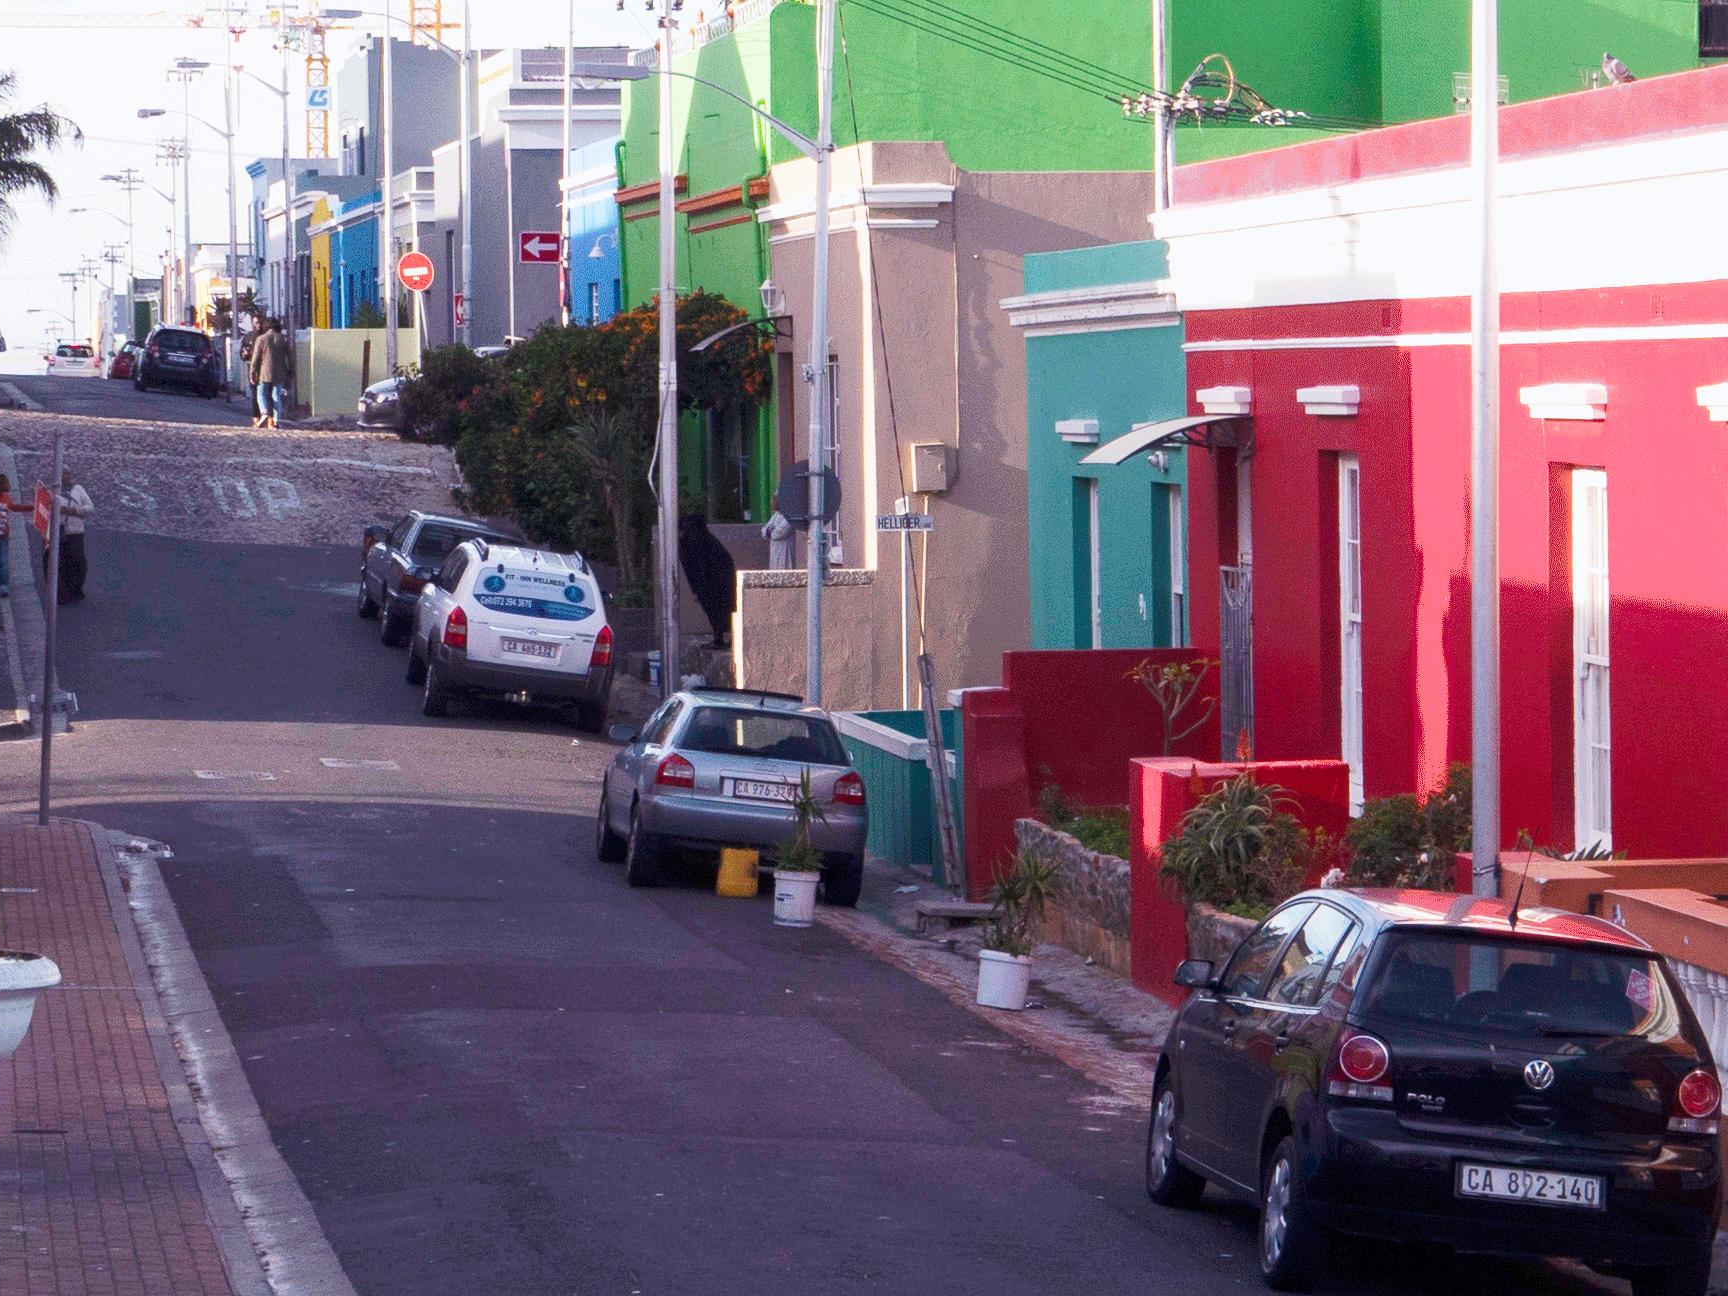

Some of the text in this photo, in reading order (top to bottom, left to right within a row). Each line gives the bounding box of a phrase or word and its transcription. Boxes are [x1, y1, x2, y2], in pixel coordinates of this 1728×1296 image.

[737, 782, 749, 794] CA
[1407, 1092, 1446, 1104] POLO
[1467, 1168, 1494, 1192] CA
